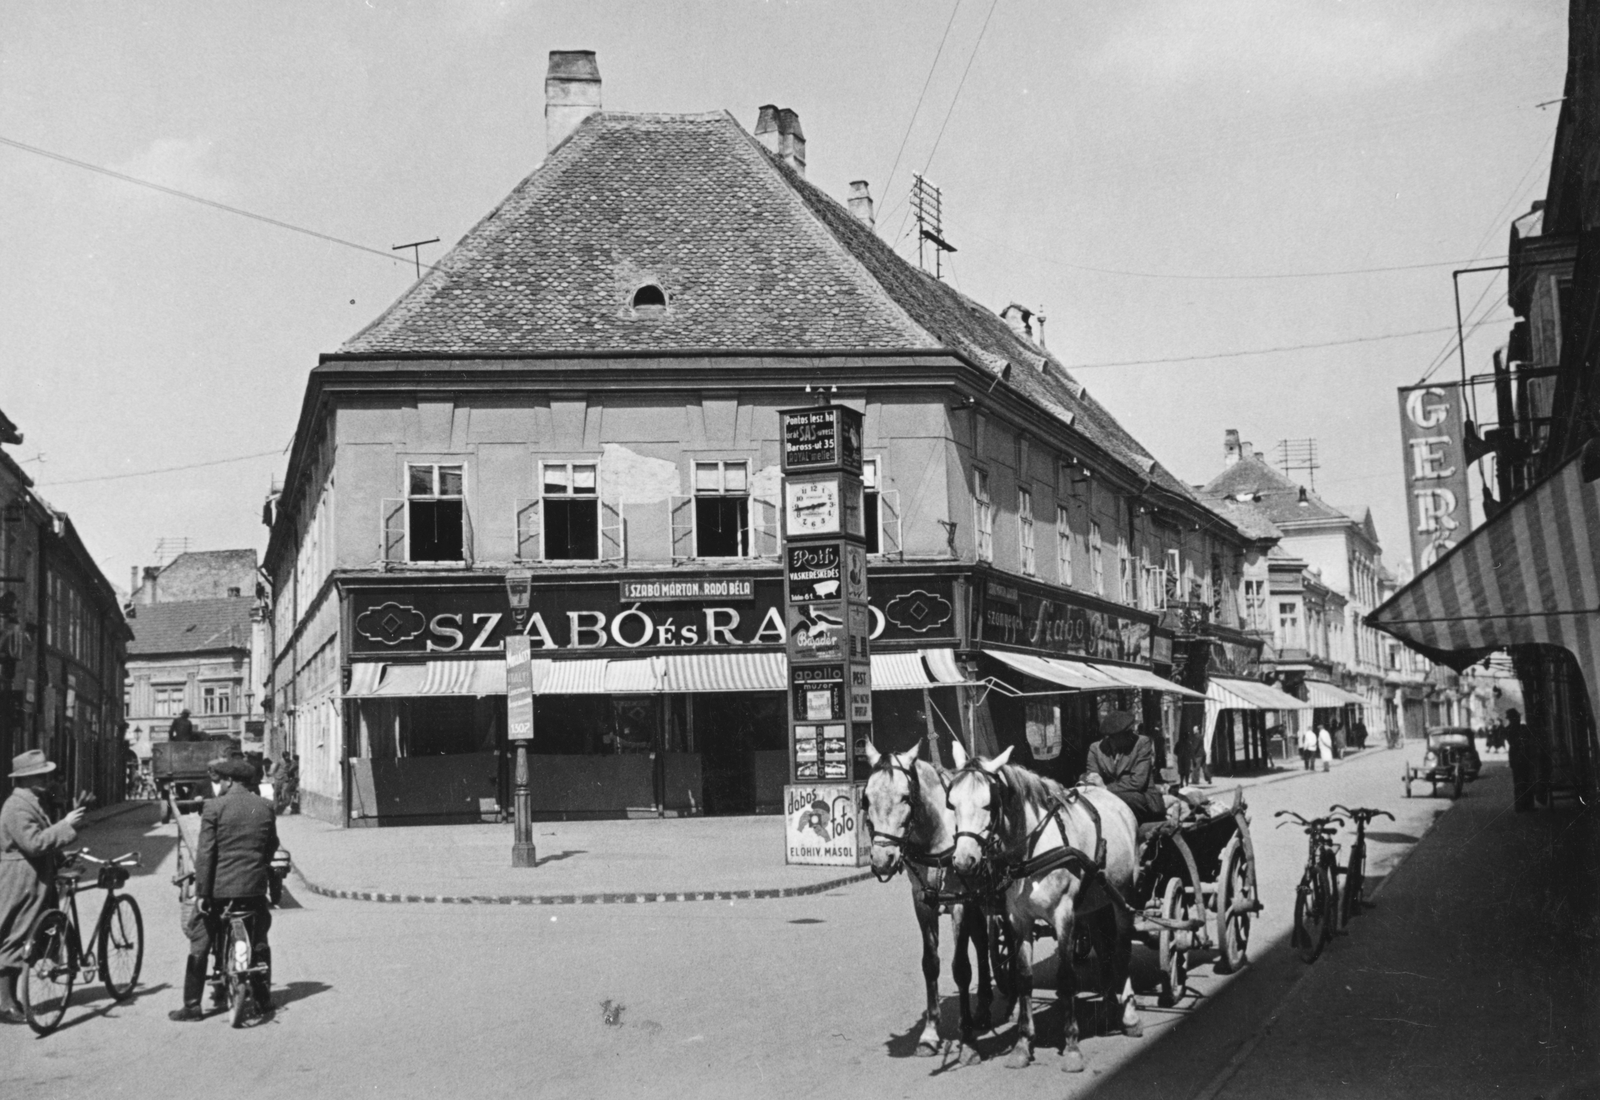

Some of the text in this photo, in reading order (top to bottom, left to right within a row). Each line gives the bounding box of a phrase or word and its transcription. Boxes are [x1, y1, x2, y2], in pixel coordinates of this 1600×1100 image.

[784, 411, 834, 425] Pontos lesz ha
[799, 425, 816, 441] SAS
[823, 439, 834, 449] 35
[789, 568, 839, 580] VASKERESKEDÉS
[630, 582, 660, 597] SZABÓ
[661, 582, 699, 597] MÁRTON
[704, 581, 728, 595] RADÓ
[729, 580, 750, 595] BÉLA
[426, 602, 654, 652] SZABÓ
[797, 630, 838, 649] Bajadér
[795, 668, 841, 679] apollo
[788, 788, 817, 815] dobos
[830, 795, 855, 839] foto
